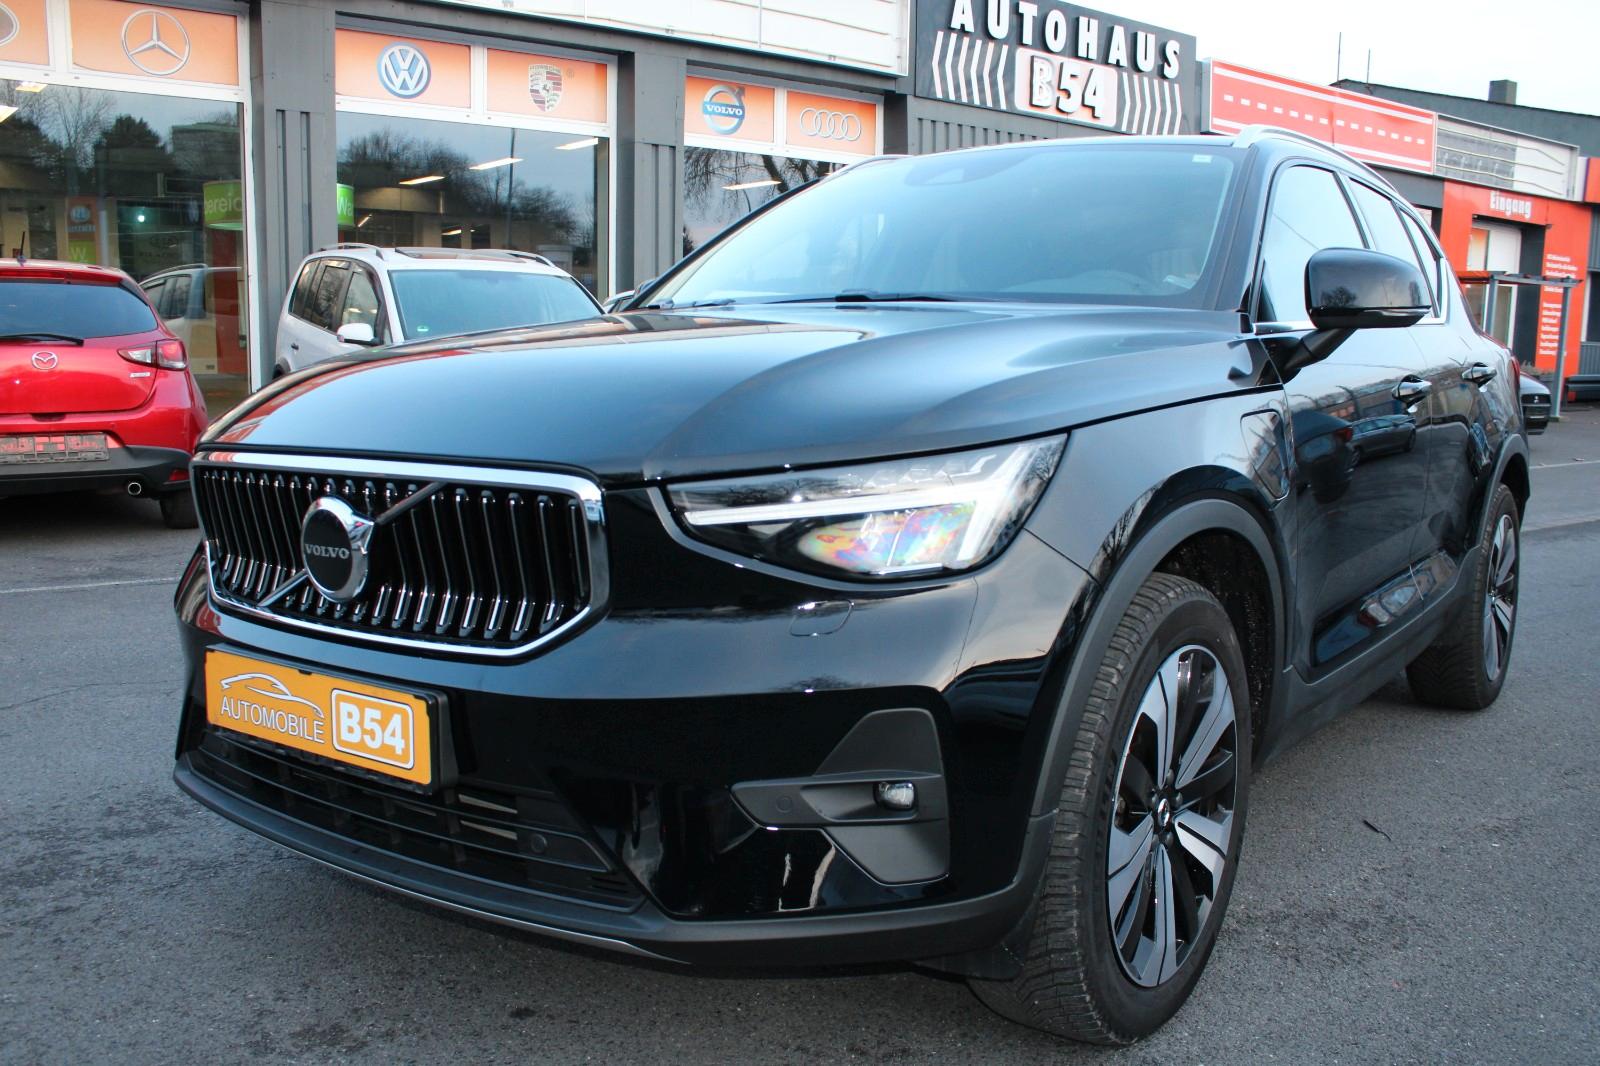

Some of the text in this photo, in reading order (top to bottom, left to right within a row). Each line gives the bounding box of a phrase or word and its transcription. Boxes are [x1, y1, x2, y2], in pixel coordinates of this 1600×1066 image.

[949, 0, 1180, 79] AUTOHAUS
[706, 104, 743, 116] VOLVO
[1031, 55, 1103, 118] B54
[1490, 191, 1532, 219] Eingang
[304, 543, 350, 559] VOLVO
[220, 695, 325, 744] AUTOMOBILE
[339, 702, 405, 755] B54
